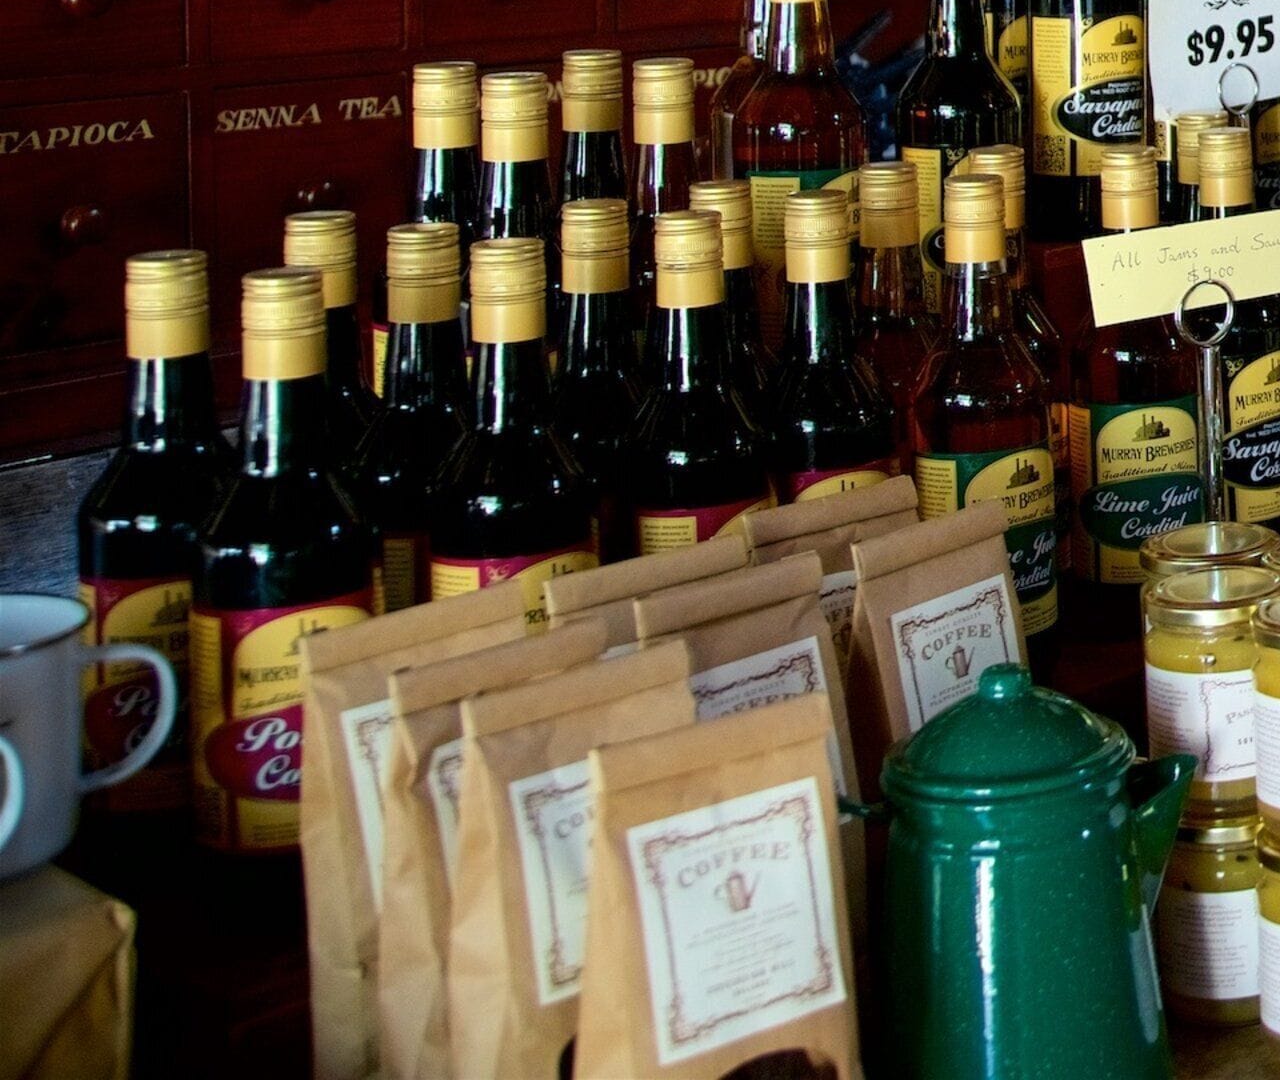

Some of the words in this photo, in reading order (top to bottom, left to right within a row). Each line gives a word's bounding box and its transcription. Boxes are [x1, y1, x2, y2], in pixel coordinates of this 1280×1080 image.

[1187, 15, 1275, 67] $9.95
[1082, 51, 1118, 65] MURRAY
[214, 102, 322, 133] SENNA
[338, 94, 402, 121] TEA
[0, 119, 155, 155] TAPIOCA
[1112, 251, 1142, 271] All
[1157, 247, 1198, 264] Jams
[1211, 236, 1241, 255] and
[1234, 389, 1273, 411] MURRAY
[1101, 446, 1143, 464] MURRAY
[1145, 437, 1196, 462] BREWERIES
[1093, 490, 1150, 514] Lime
[1153, 485, 1200, 515] Juice
[1120, 512, 1187, 540] Cordial
[1013, 559, 1053, 589] ordial
[921, 623, 992, 661] COFFEE
[677, 841, 790, 888] COFFEE
